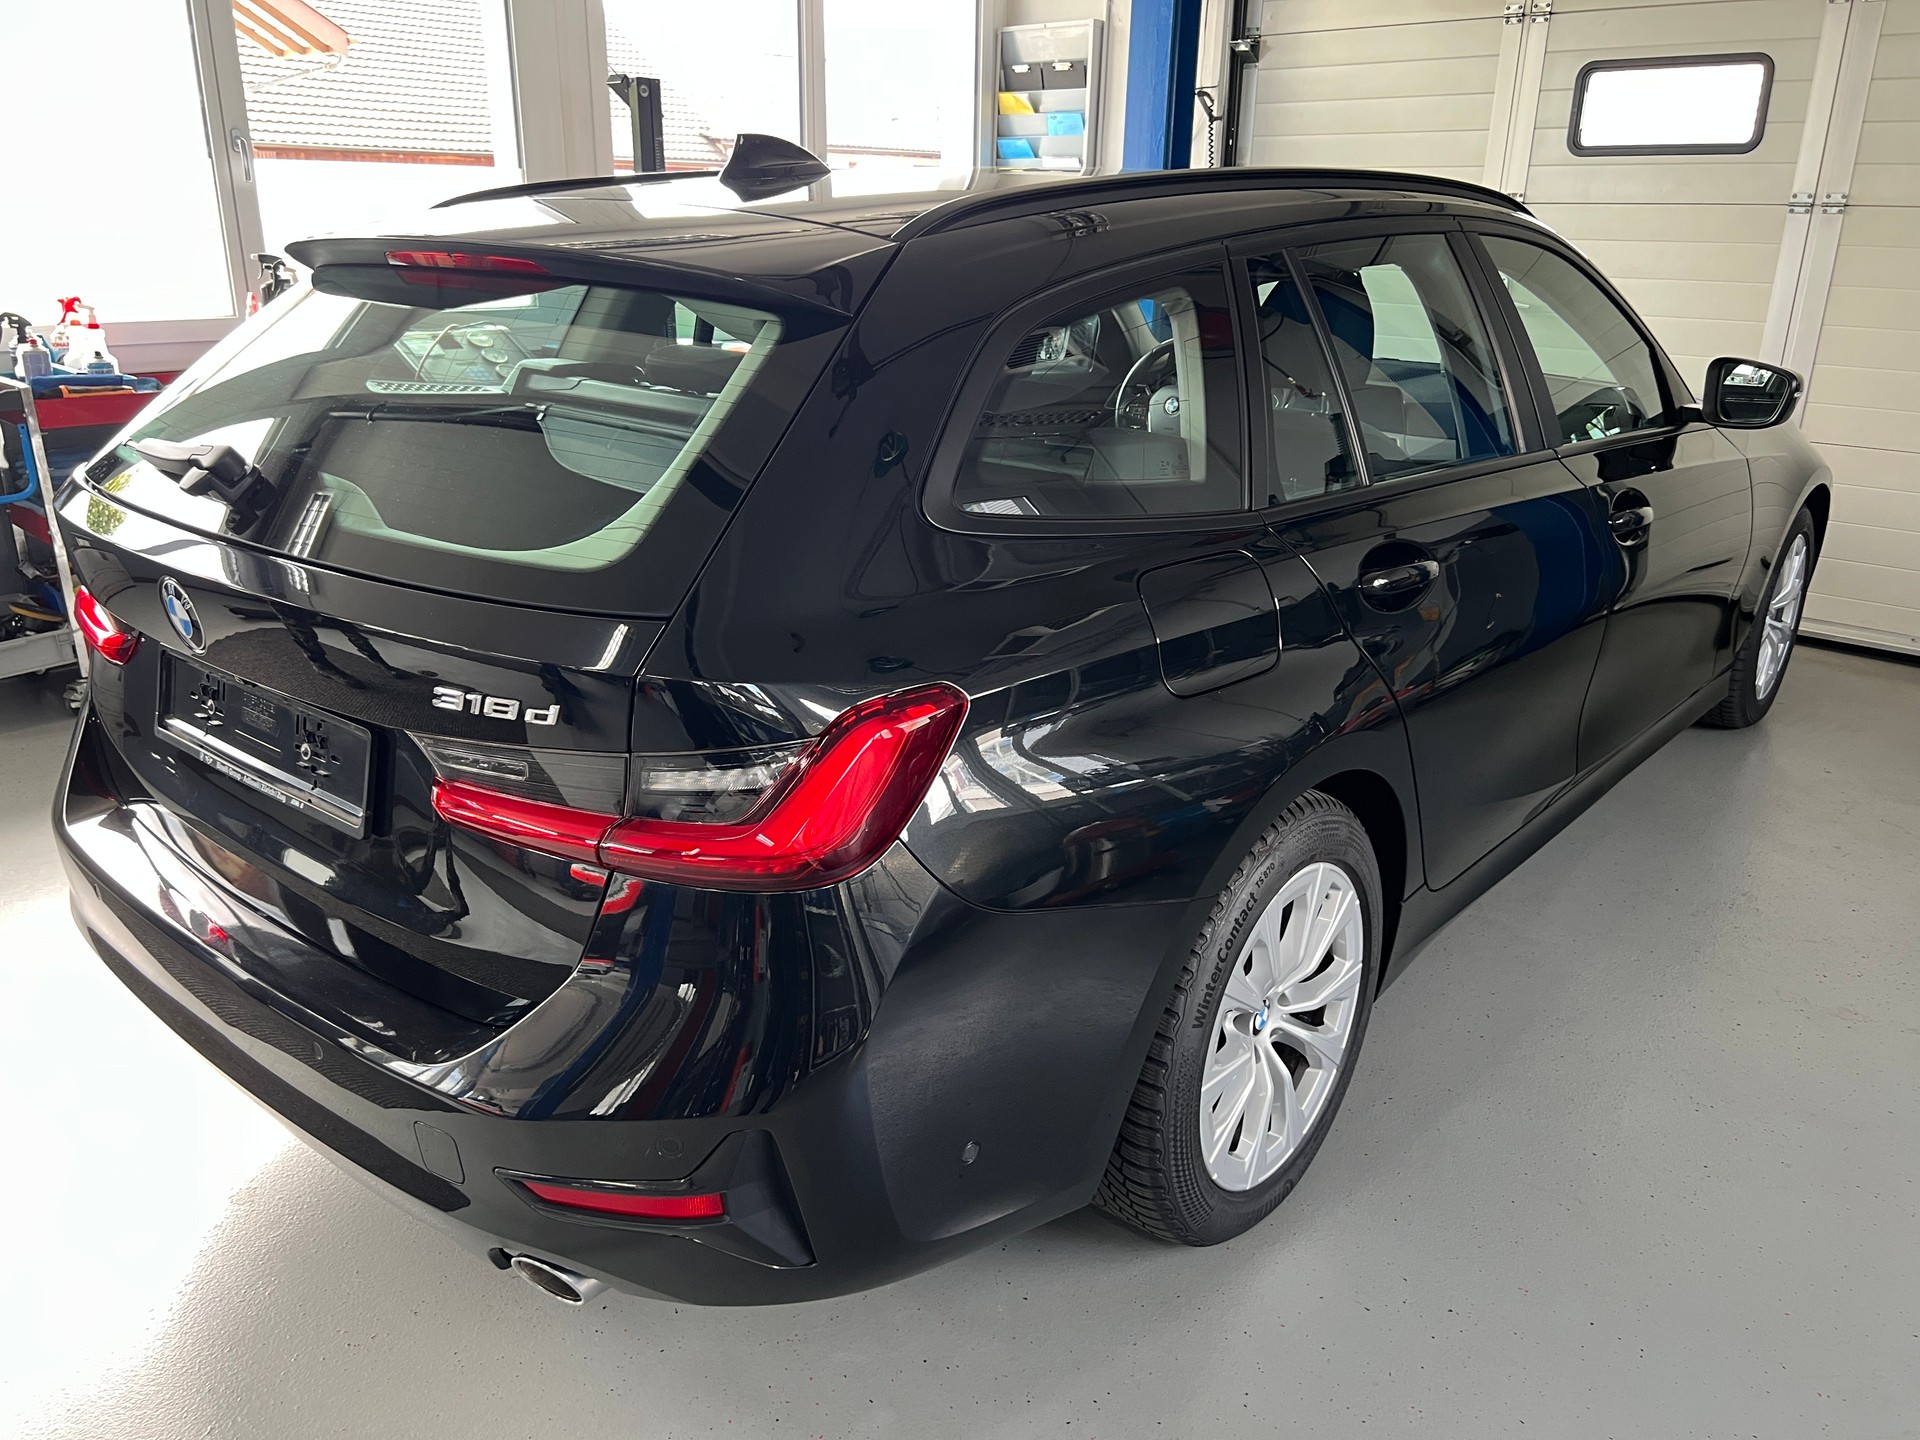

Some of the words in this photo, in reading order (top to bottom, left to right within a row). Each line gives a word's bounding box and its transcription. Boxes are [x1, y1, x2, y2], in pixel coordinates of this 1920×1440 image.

[1192, 892, 1258, 1029] WinterContact
[1255, 876, 1264, 888] TS
[1263, 862, 1275, 879] 870
